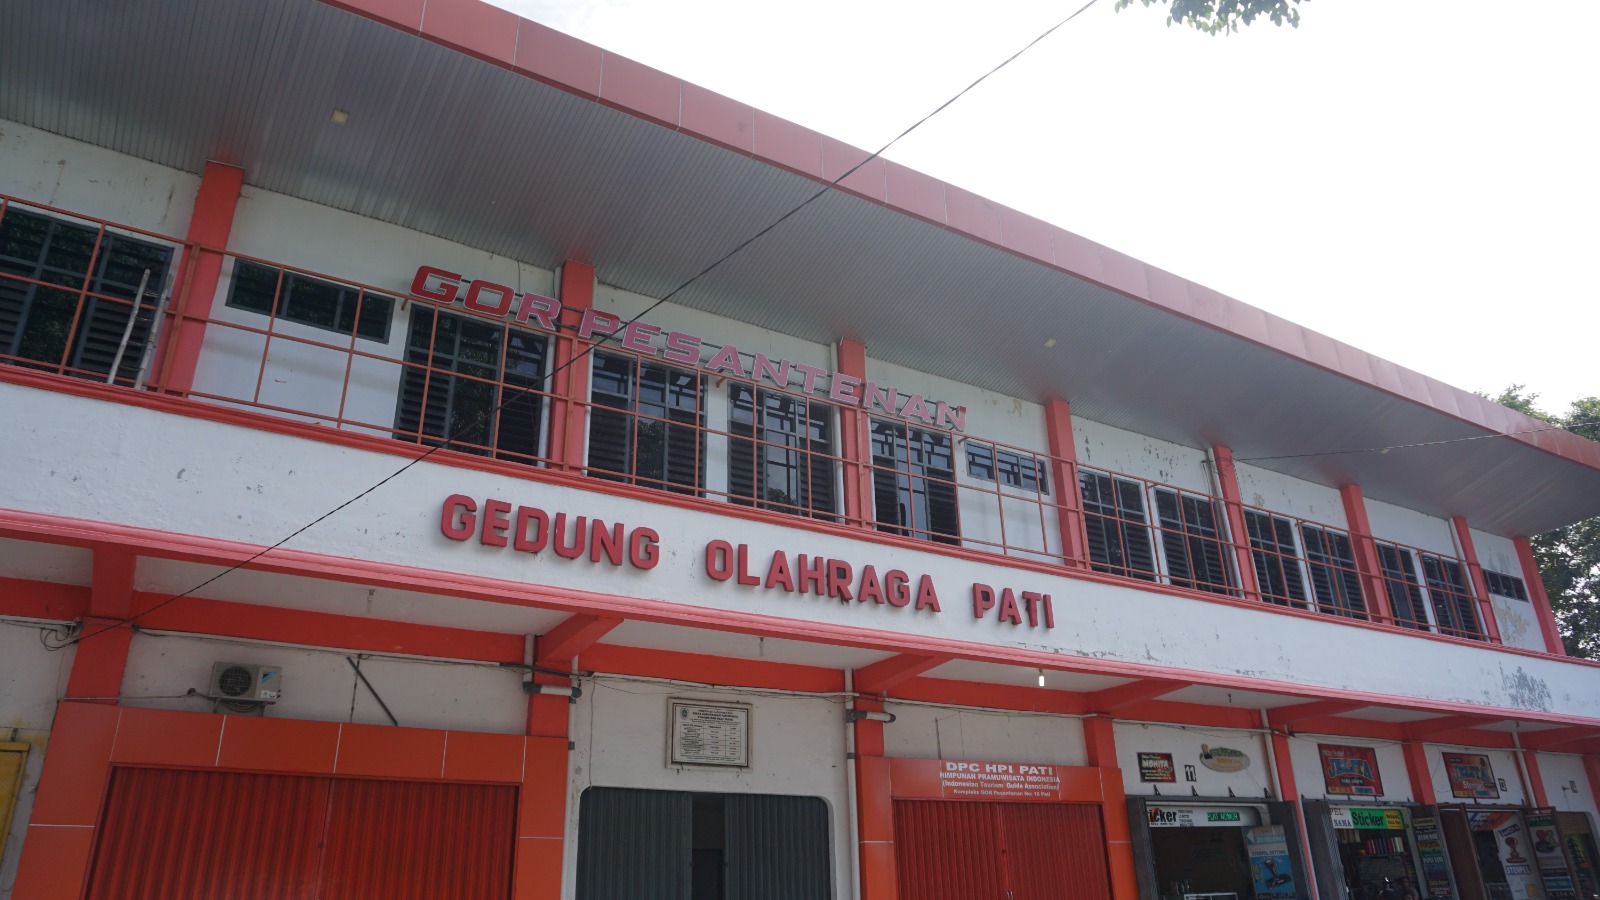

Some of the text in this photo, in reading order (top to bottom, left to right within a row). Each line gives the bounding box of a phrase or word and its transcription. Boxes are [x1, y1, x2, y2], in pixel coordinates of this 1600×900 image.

[411, 265, 966, 431] GOR PESANTENAN
[441, 494, 1054, 628] GEDUNG OLAHRAGA PATI
[940, 772, 976, 780] HIMPUNAN
[978, 773, 1025, 782] PRAMUWISATA
[945, 762, 1053, 776] DPC HPI PATI
[1185, 766, 1197, 782] 11
[1148, 809, 1177, 822] icker
[1351, 811, 1384, 827] Sticker
